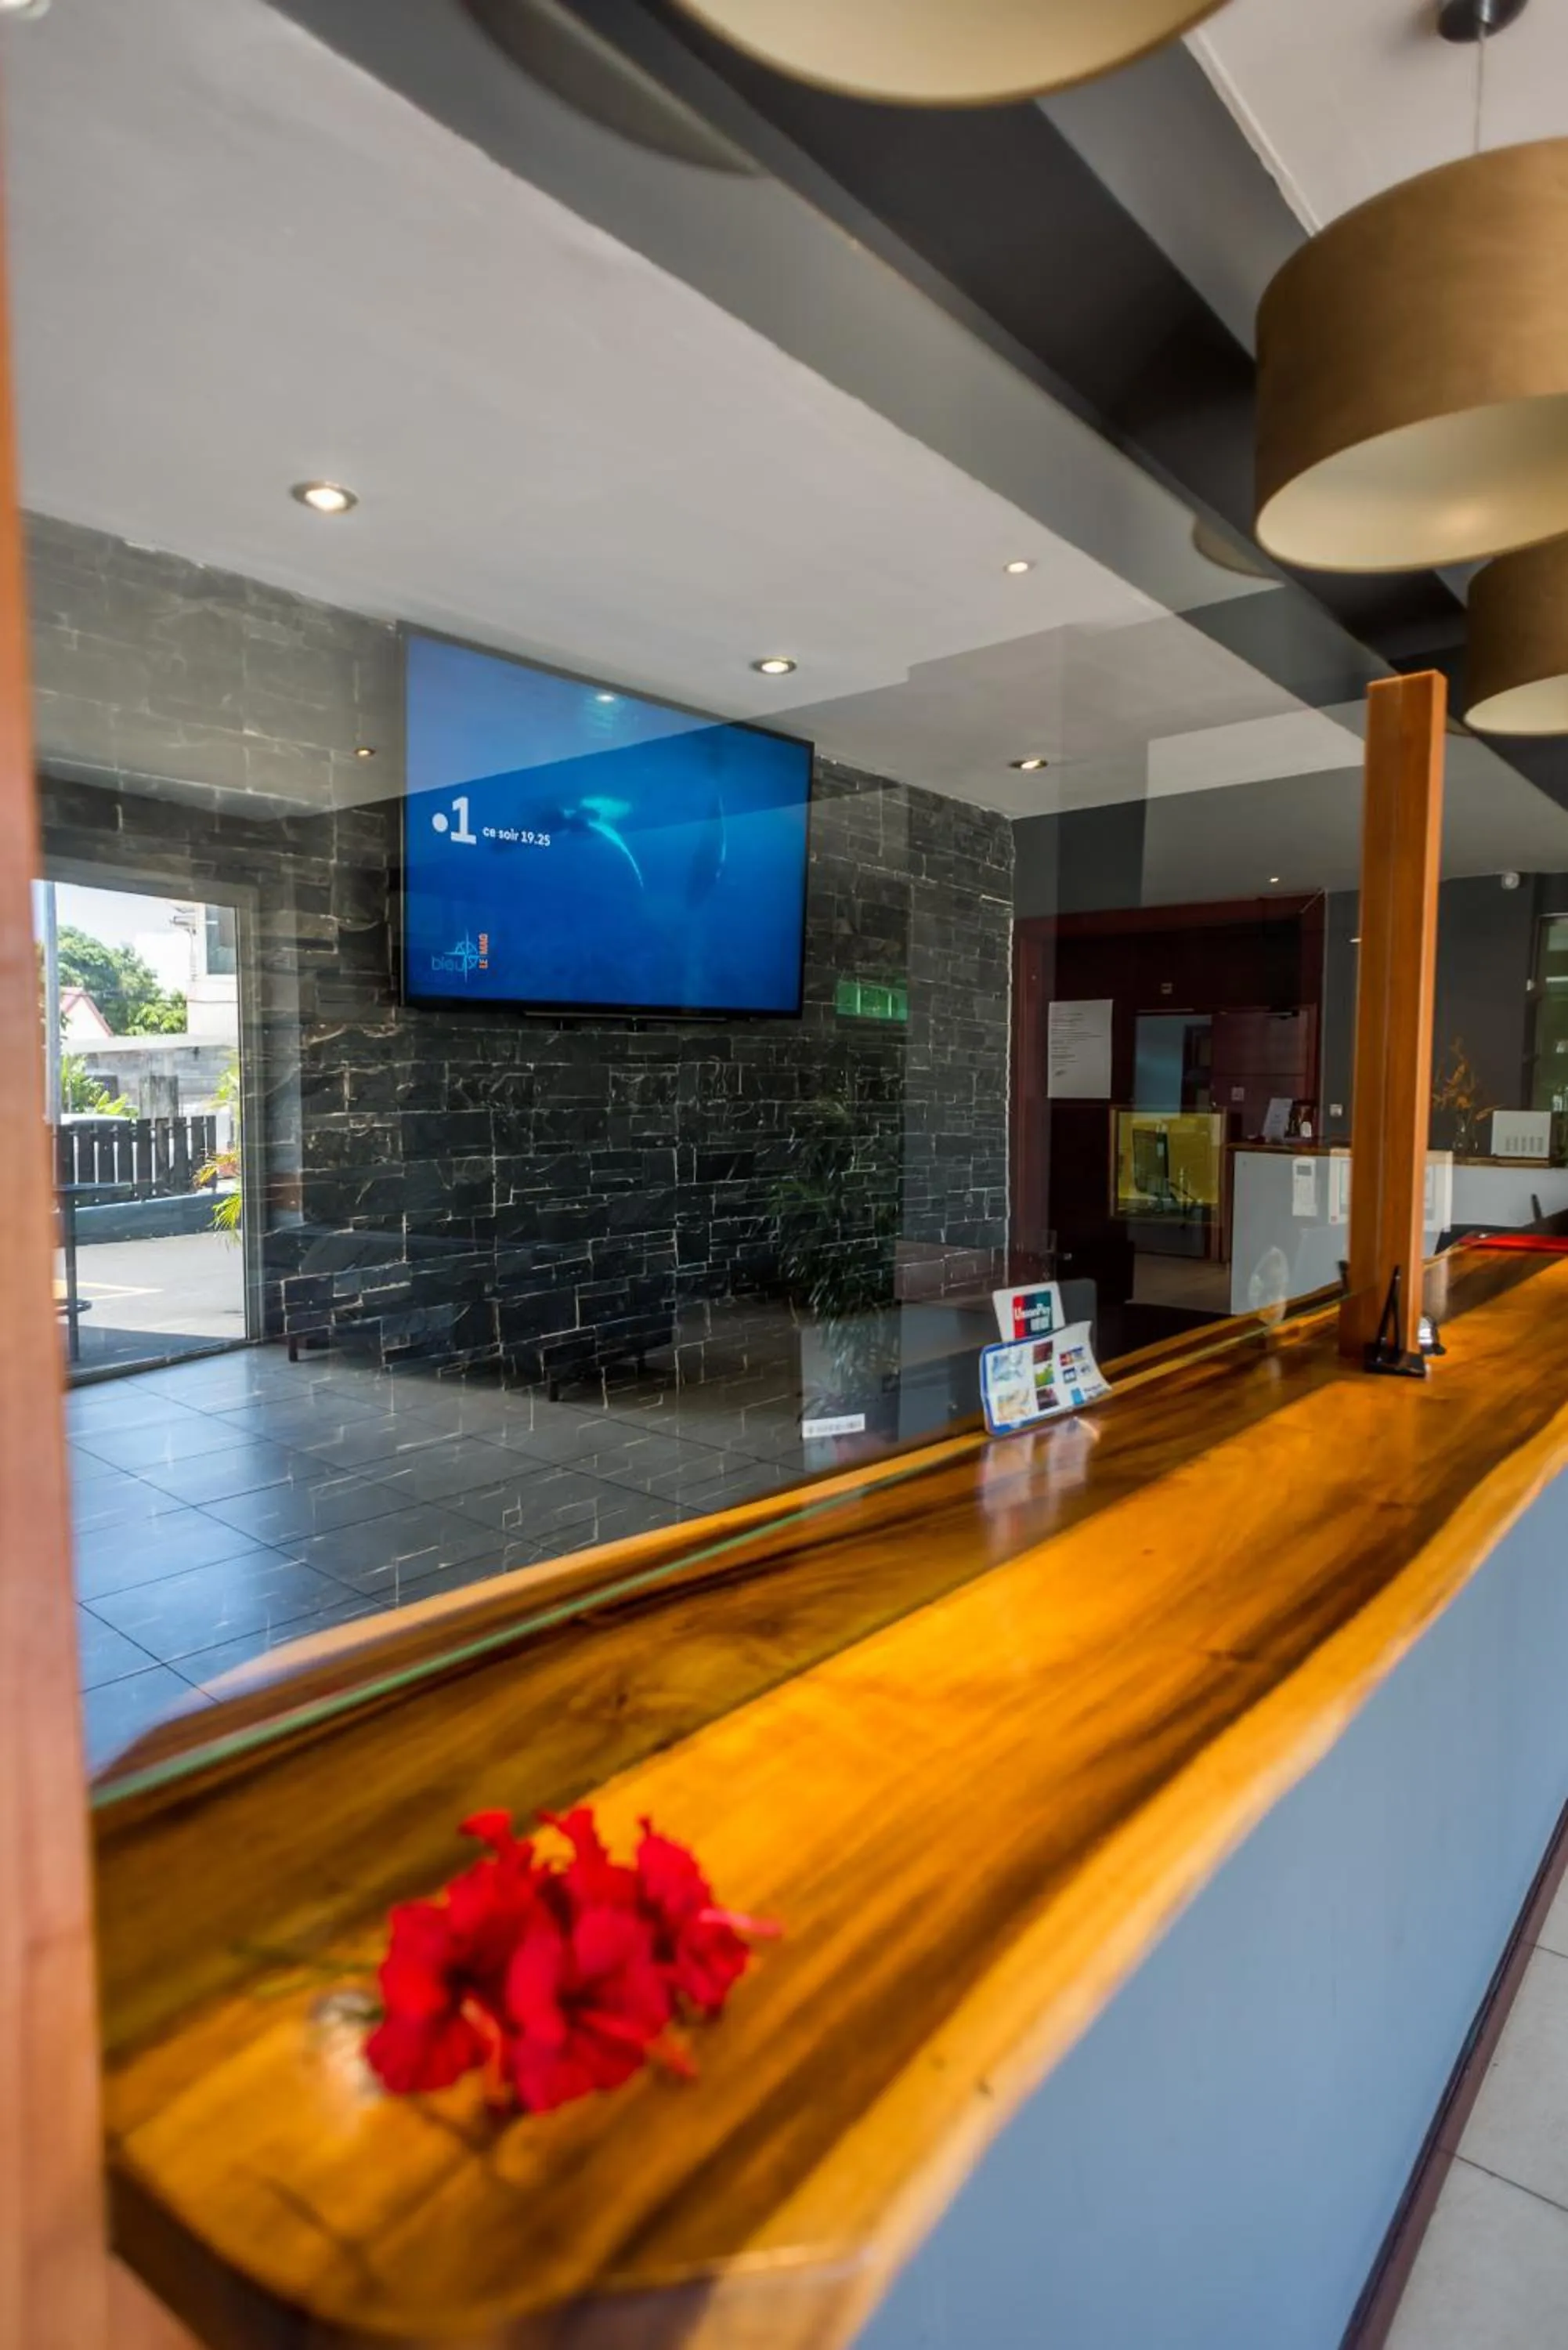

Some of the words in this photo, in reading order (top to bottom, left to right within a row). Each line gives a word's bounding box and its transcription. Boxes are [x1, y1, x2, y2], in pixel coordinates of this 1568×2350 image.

[451, 796, 477, 844] 1
[482, 826, 496, 837] ce
[499, 829, 518, 841] soir
[521, 830, 551, 847] 19.25
